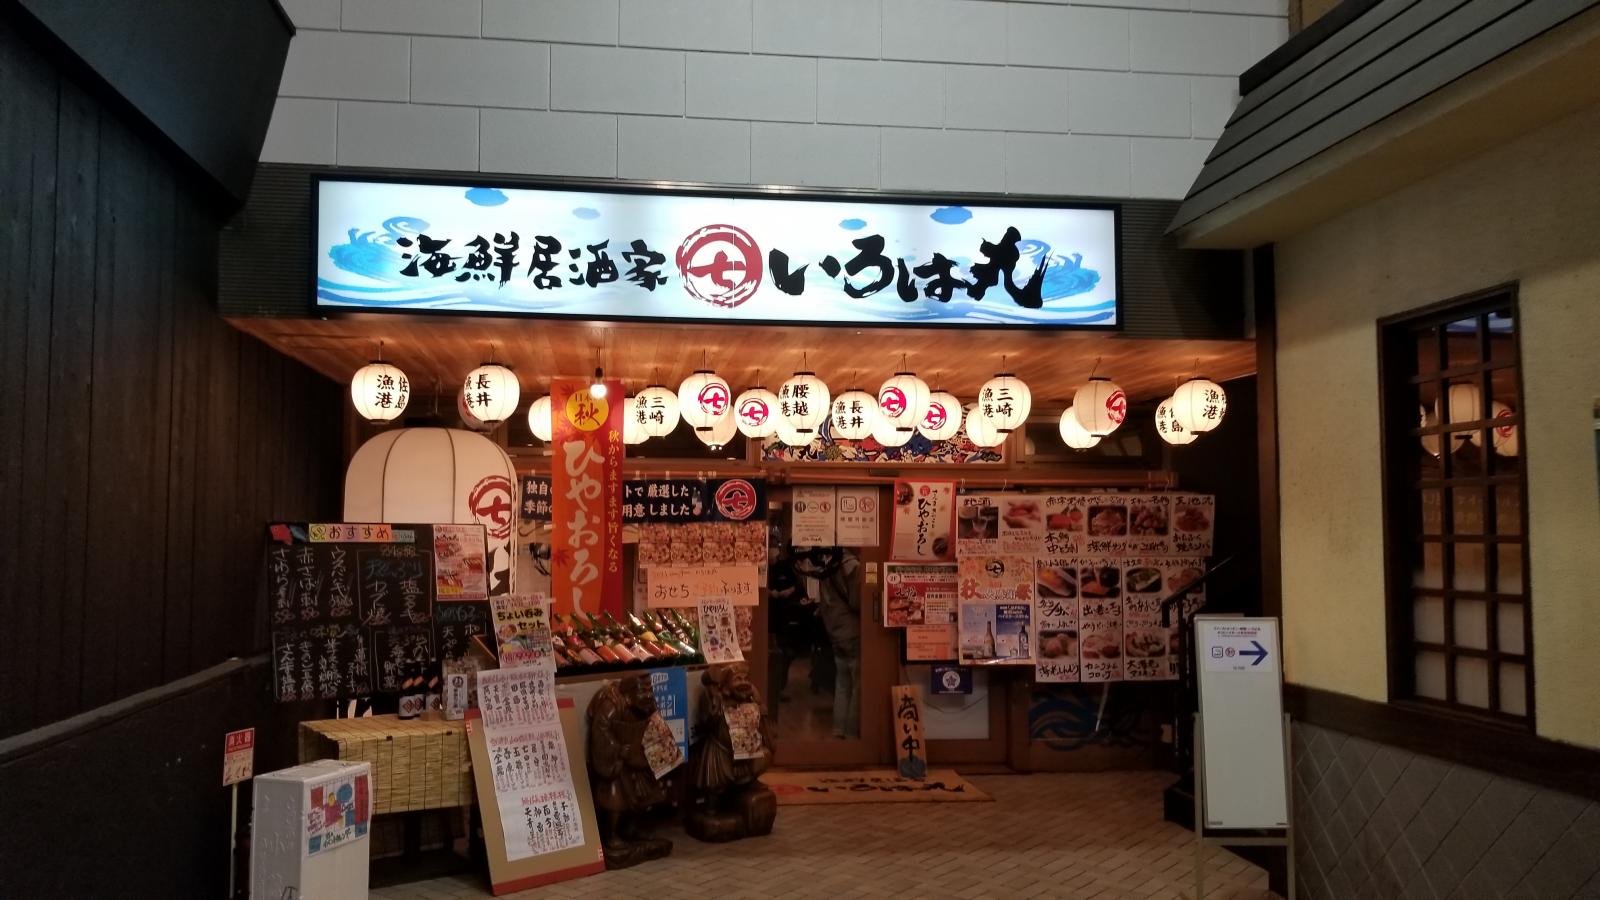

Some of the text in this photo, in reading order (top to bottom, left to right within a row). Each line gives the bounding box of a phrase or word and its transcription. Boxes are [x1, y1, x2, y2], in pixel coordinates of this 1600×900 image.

[396, 231, 669, 291] 海鮮居酒家
[769, 226, 1055, 309] いろは丸
[375, 374, 394, 408] 漁港
[476, 374, 493, 407] 長井
[792, 383, 810, 416] 腰越
[982, 388, 994, 418] 漁港
[995, 388, 1014, 417] 三崎
[1203, 388, 1219, 420] 漁港
[575, 403, 601, 425] 秋
[636, 396, 648, 424] 漁港
[649, 396, 665, 424] 三崎
[835, 401, 848, 429] 漁港
[849, 400, 864, 428] 長井
[329, 525, 389, 541] おすすめ
[563, 440, 605, 630] ひやおろし
[917, 498, 931, 556] ひやおろし
[655, 582, 690, 600] おせち
[518, 619, 545, 631] セット
[897, 694, 920, 762] 商い中
